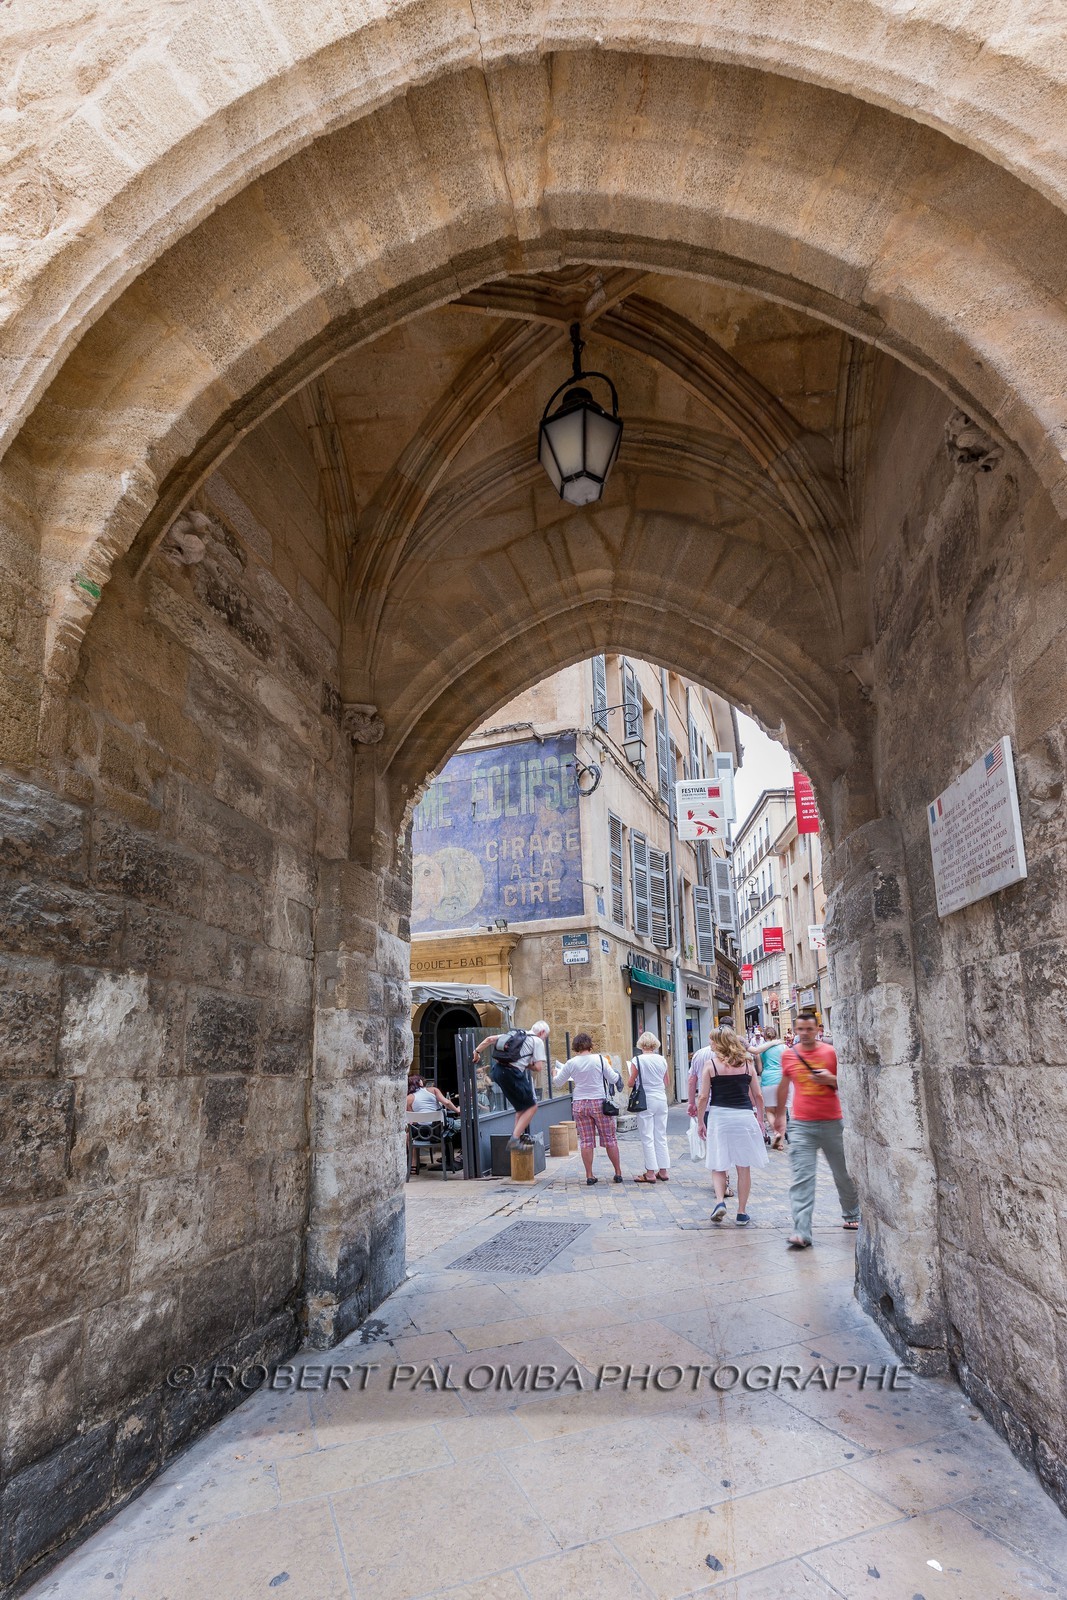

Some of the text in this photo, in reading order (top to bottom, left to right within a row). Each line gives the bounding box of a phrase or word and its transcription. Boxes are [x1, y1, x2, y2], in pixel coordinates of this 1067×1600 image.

[486, 828, 580, 862] CIRAGE
[529, 859, 554, 878] LA
[503, 879, 562, 907] CIRE
